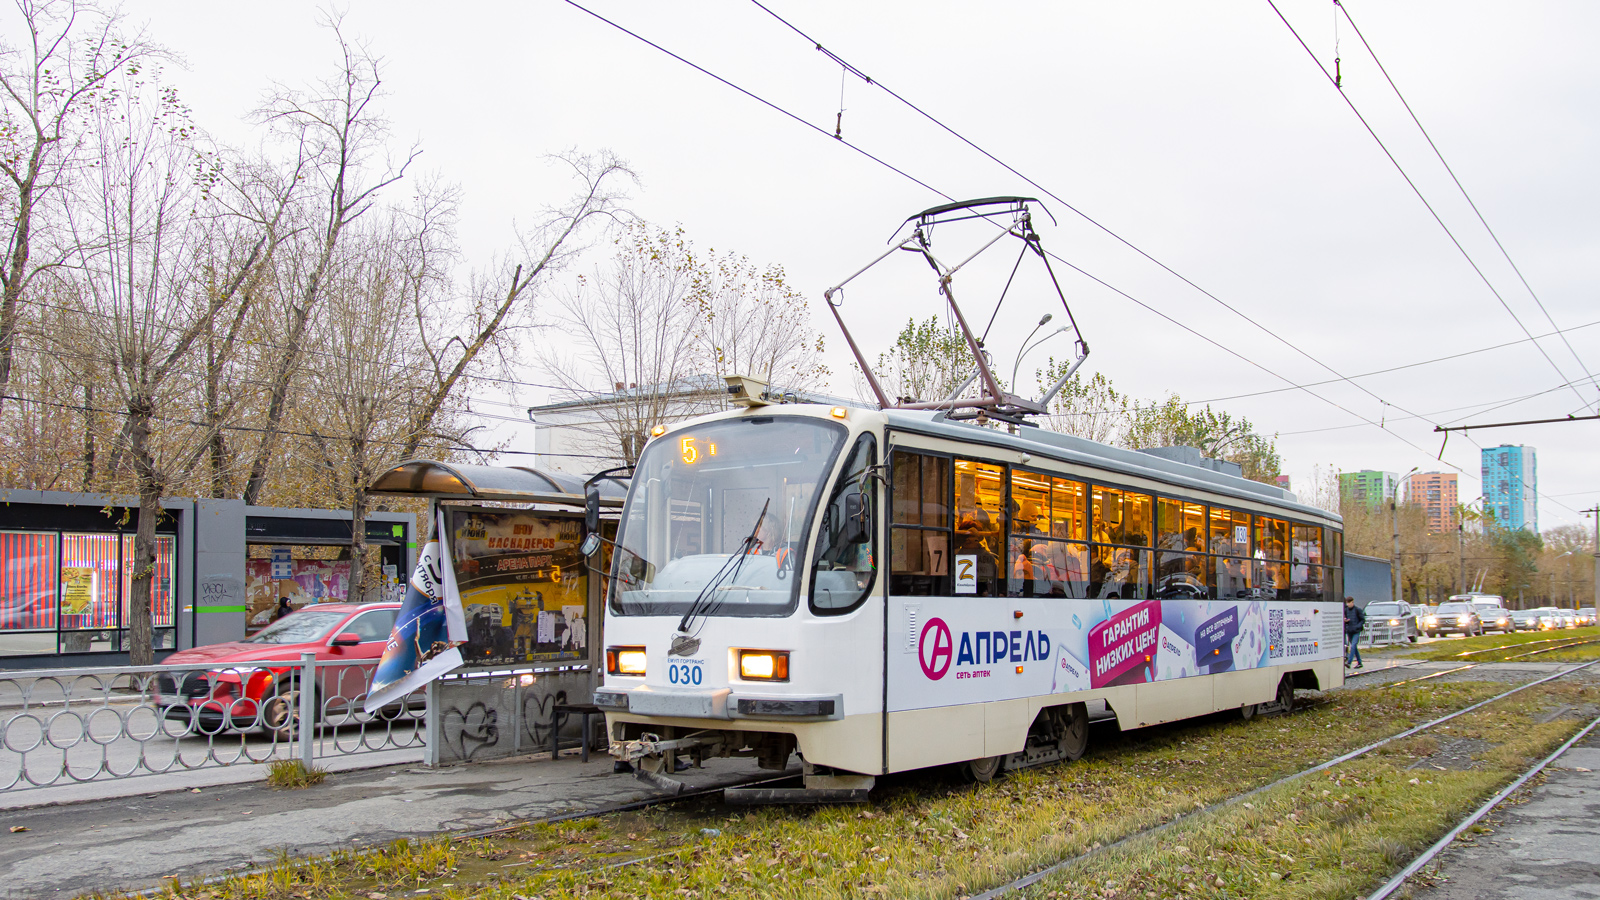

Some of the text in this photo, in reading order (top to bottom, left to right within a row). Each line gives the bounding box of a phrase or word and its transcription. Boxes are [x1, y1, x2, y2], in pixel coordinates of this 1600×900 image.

[681, 437, 698, 464] 5
[513, 524, 534, 535] ШОУ
[1235, 526, 1247, 543] 030
[488, 537, 556, 550] КАСКАДЕРОВ
[497, 555, 553, 571] АРЕНА ПАРК
[933, 550, 943, 573] 7
[1102, 607, 1150, 648] ГАРАНТИЯ
[1200, 628, 1206, 639] на
[1206, 624, 1214, 636] все
[1209, 631, 1226, 644] товары
[956, 630, 1051, 666] АПРЕЛЬ
[1095, 641, 1135, 678] НИЗКИХ
[669, 664, 703, 686] 030
[956, 669, 991, 680] сеть аптек
